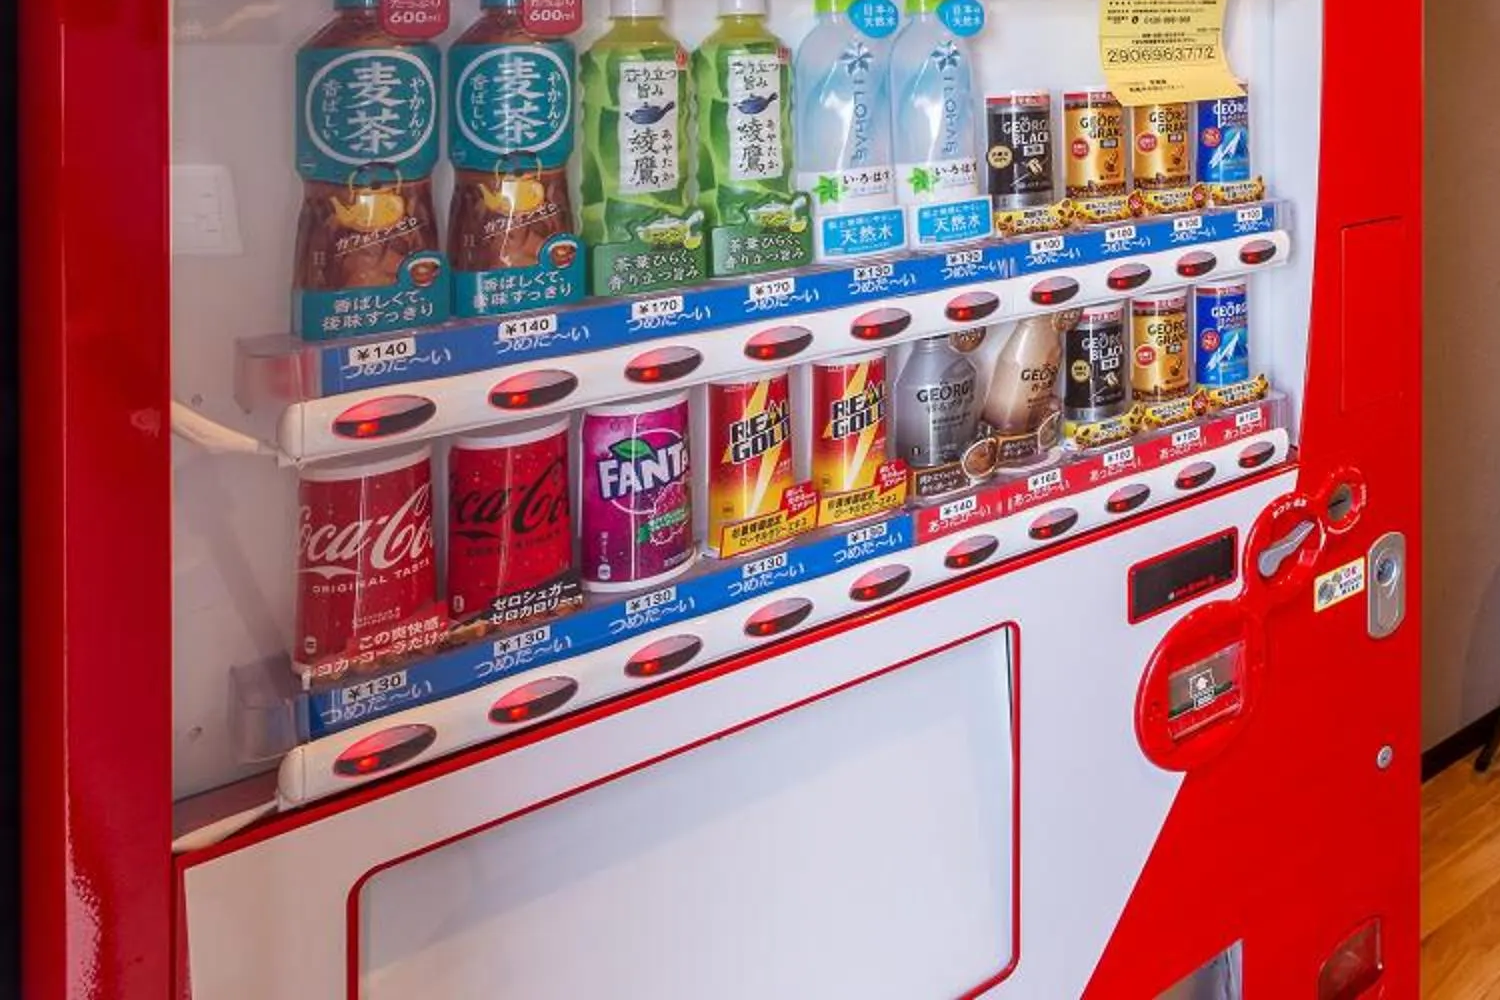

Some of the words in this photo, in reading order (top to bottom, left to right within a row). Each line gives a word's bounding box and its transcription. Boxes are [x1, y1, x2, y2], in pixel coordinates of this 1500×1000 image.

[344, 60, 406, 155] 麦茶
[487, 55, 545, 145] 麦茶
[628, 126, 662, 188] 綾鷹
[737, 117, 767, 176] 綾鷹
[840, 225, 893, 245] 天然水
[934, 214, 981, 233] 天然水
[505, 319, 550, 335] ¥140
[356, 341, 408, 360] ¥140
[491, 582, 577, 611] ゼロシュガー
[629, 590, 672, 610] ¥130
[499, 629, 546, 652] ¥130
[348, 674, 402, 698] ¥130
